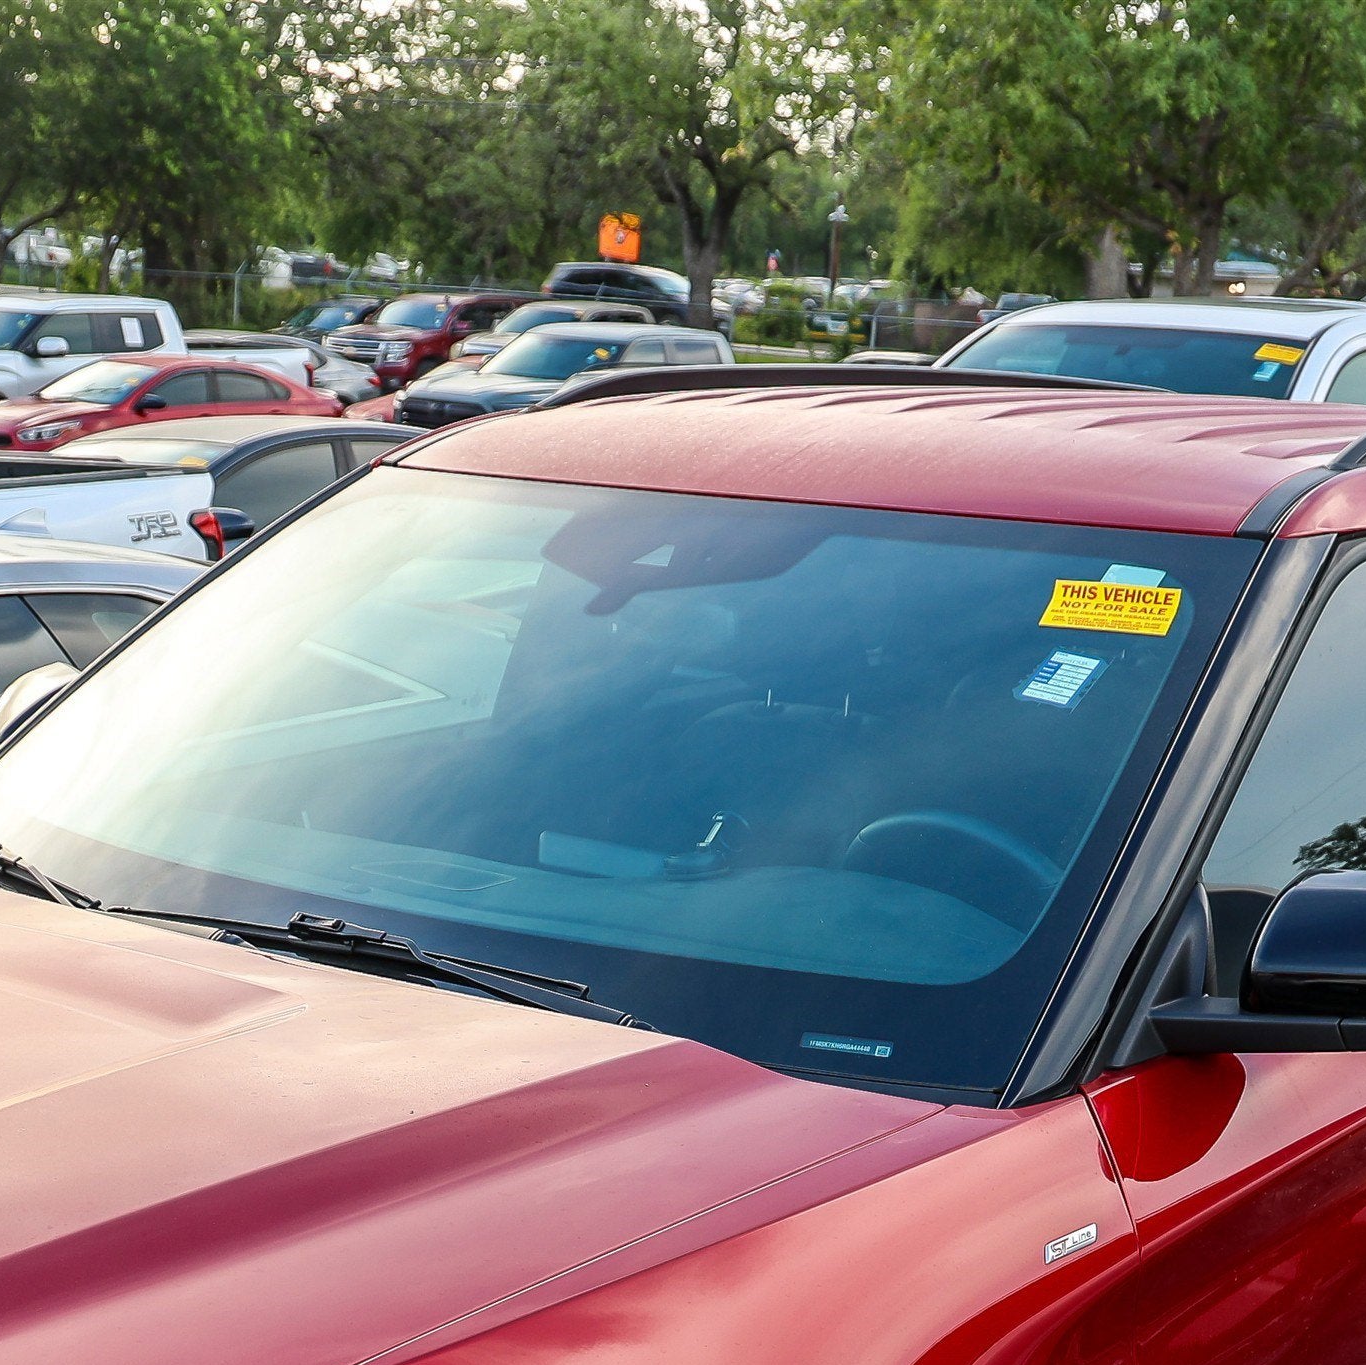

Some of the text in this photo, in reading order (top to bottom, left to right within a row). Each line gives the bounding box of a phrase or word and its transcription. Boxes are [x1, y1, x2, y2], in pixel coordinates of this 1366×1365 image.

[1061, 584, 1176, 606] THIS VEHICLE
[1060, 600, 1168, 616] NOT FOR SALE
[1050, 1230, 1092, 1260] ST Line
